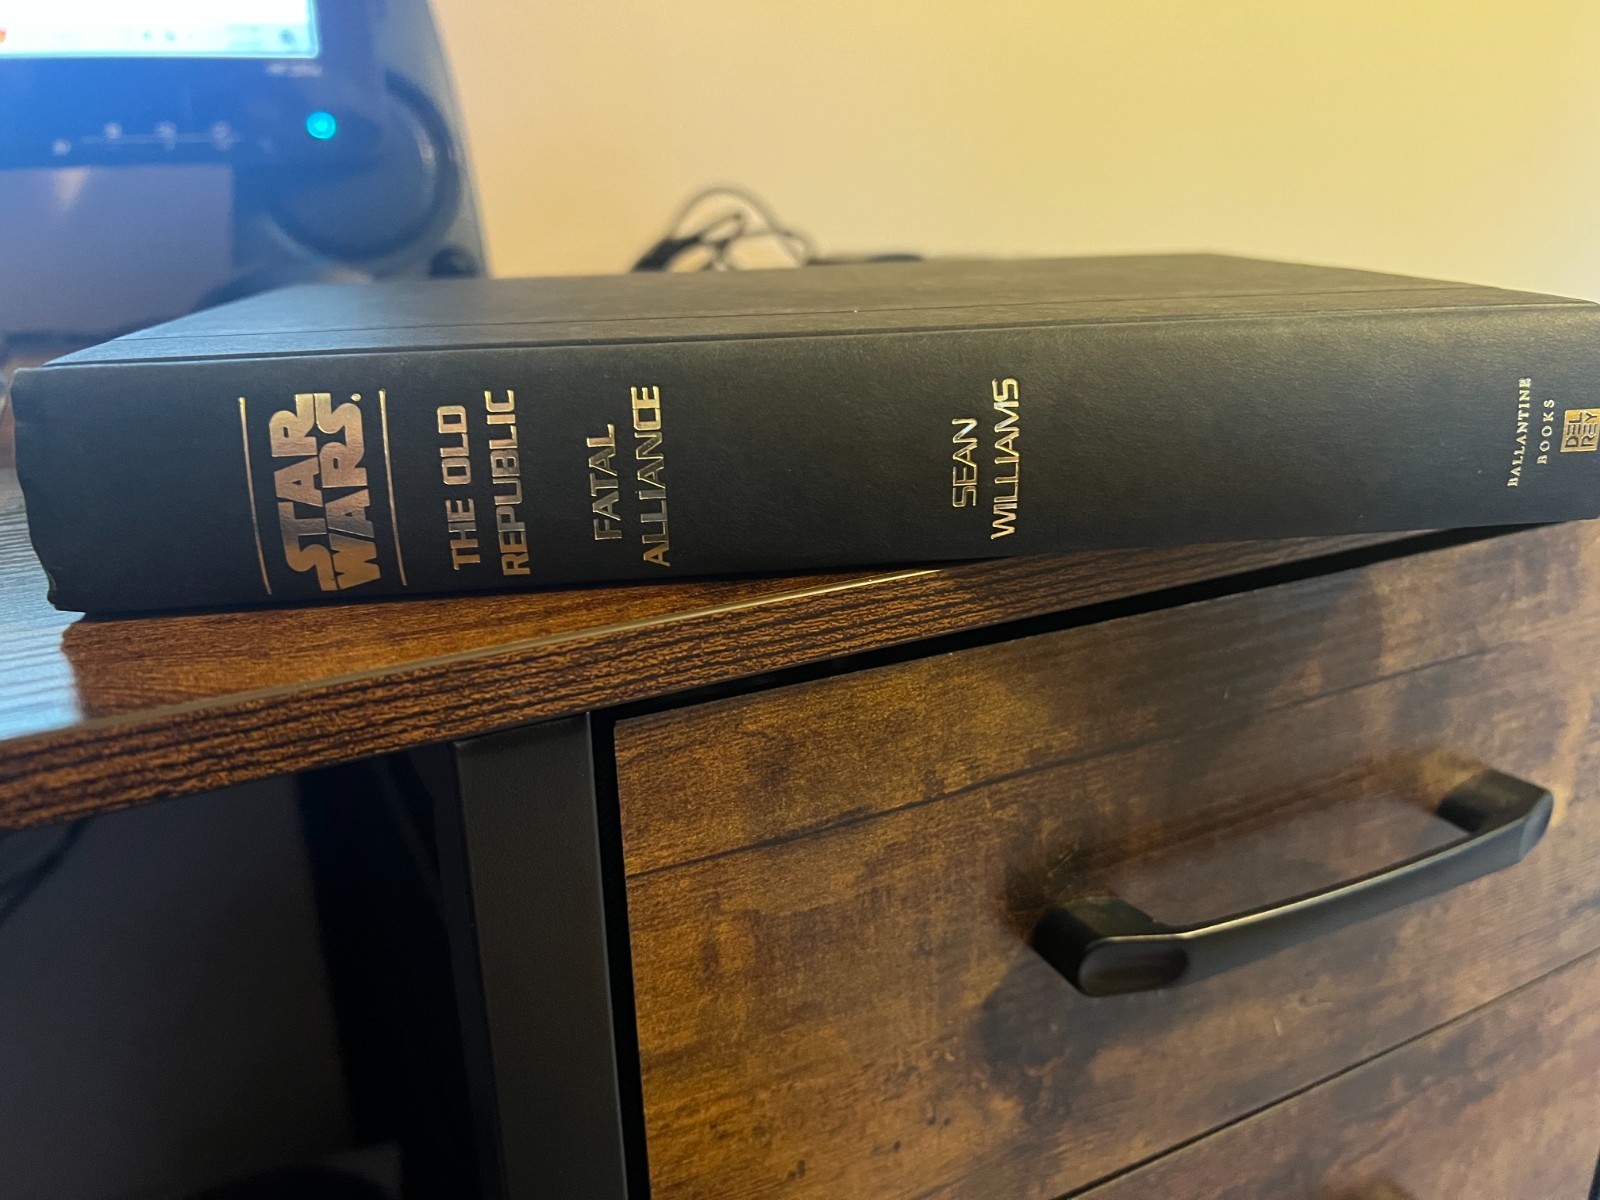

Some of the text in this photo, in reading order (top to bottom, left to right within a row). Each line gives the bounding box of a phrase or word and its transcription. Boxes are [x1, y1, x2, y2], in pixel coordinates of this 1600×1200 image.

[437, 405, 481, 571] THE OLD
[484, 389, 531, 576] REPUBLIC
[586, 423, 622, 541] FATAL
[630, 385, 671, 567] ALLIANCE
[951, 418, 978, 508] SEAN
[990, 378, 1020, 540] WILLIAMS
[1506, 377, 1532, 487] BALLANTINE
[1536, 399, 1555, 465] BOOKS
[1564, 412, 1583, 448] DEL
[1580, 412, 1598, 448] REY
[269, 393, 339, 591] STAR
